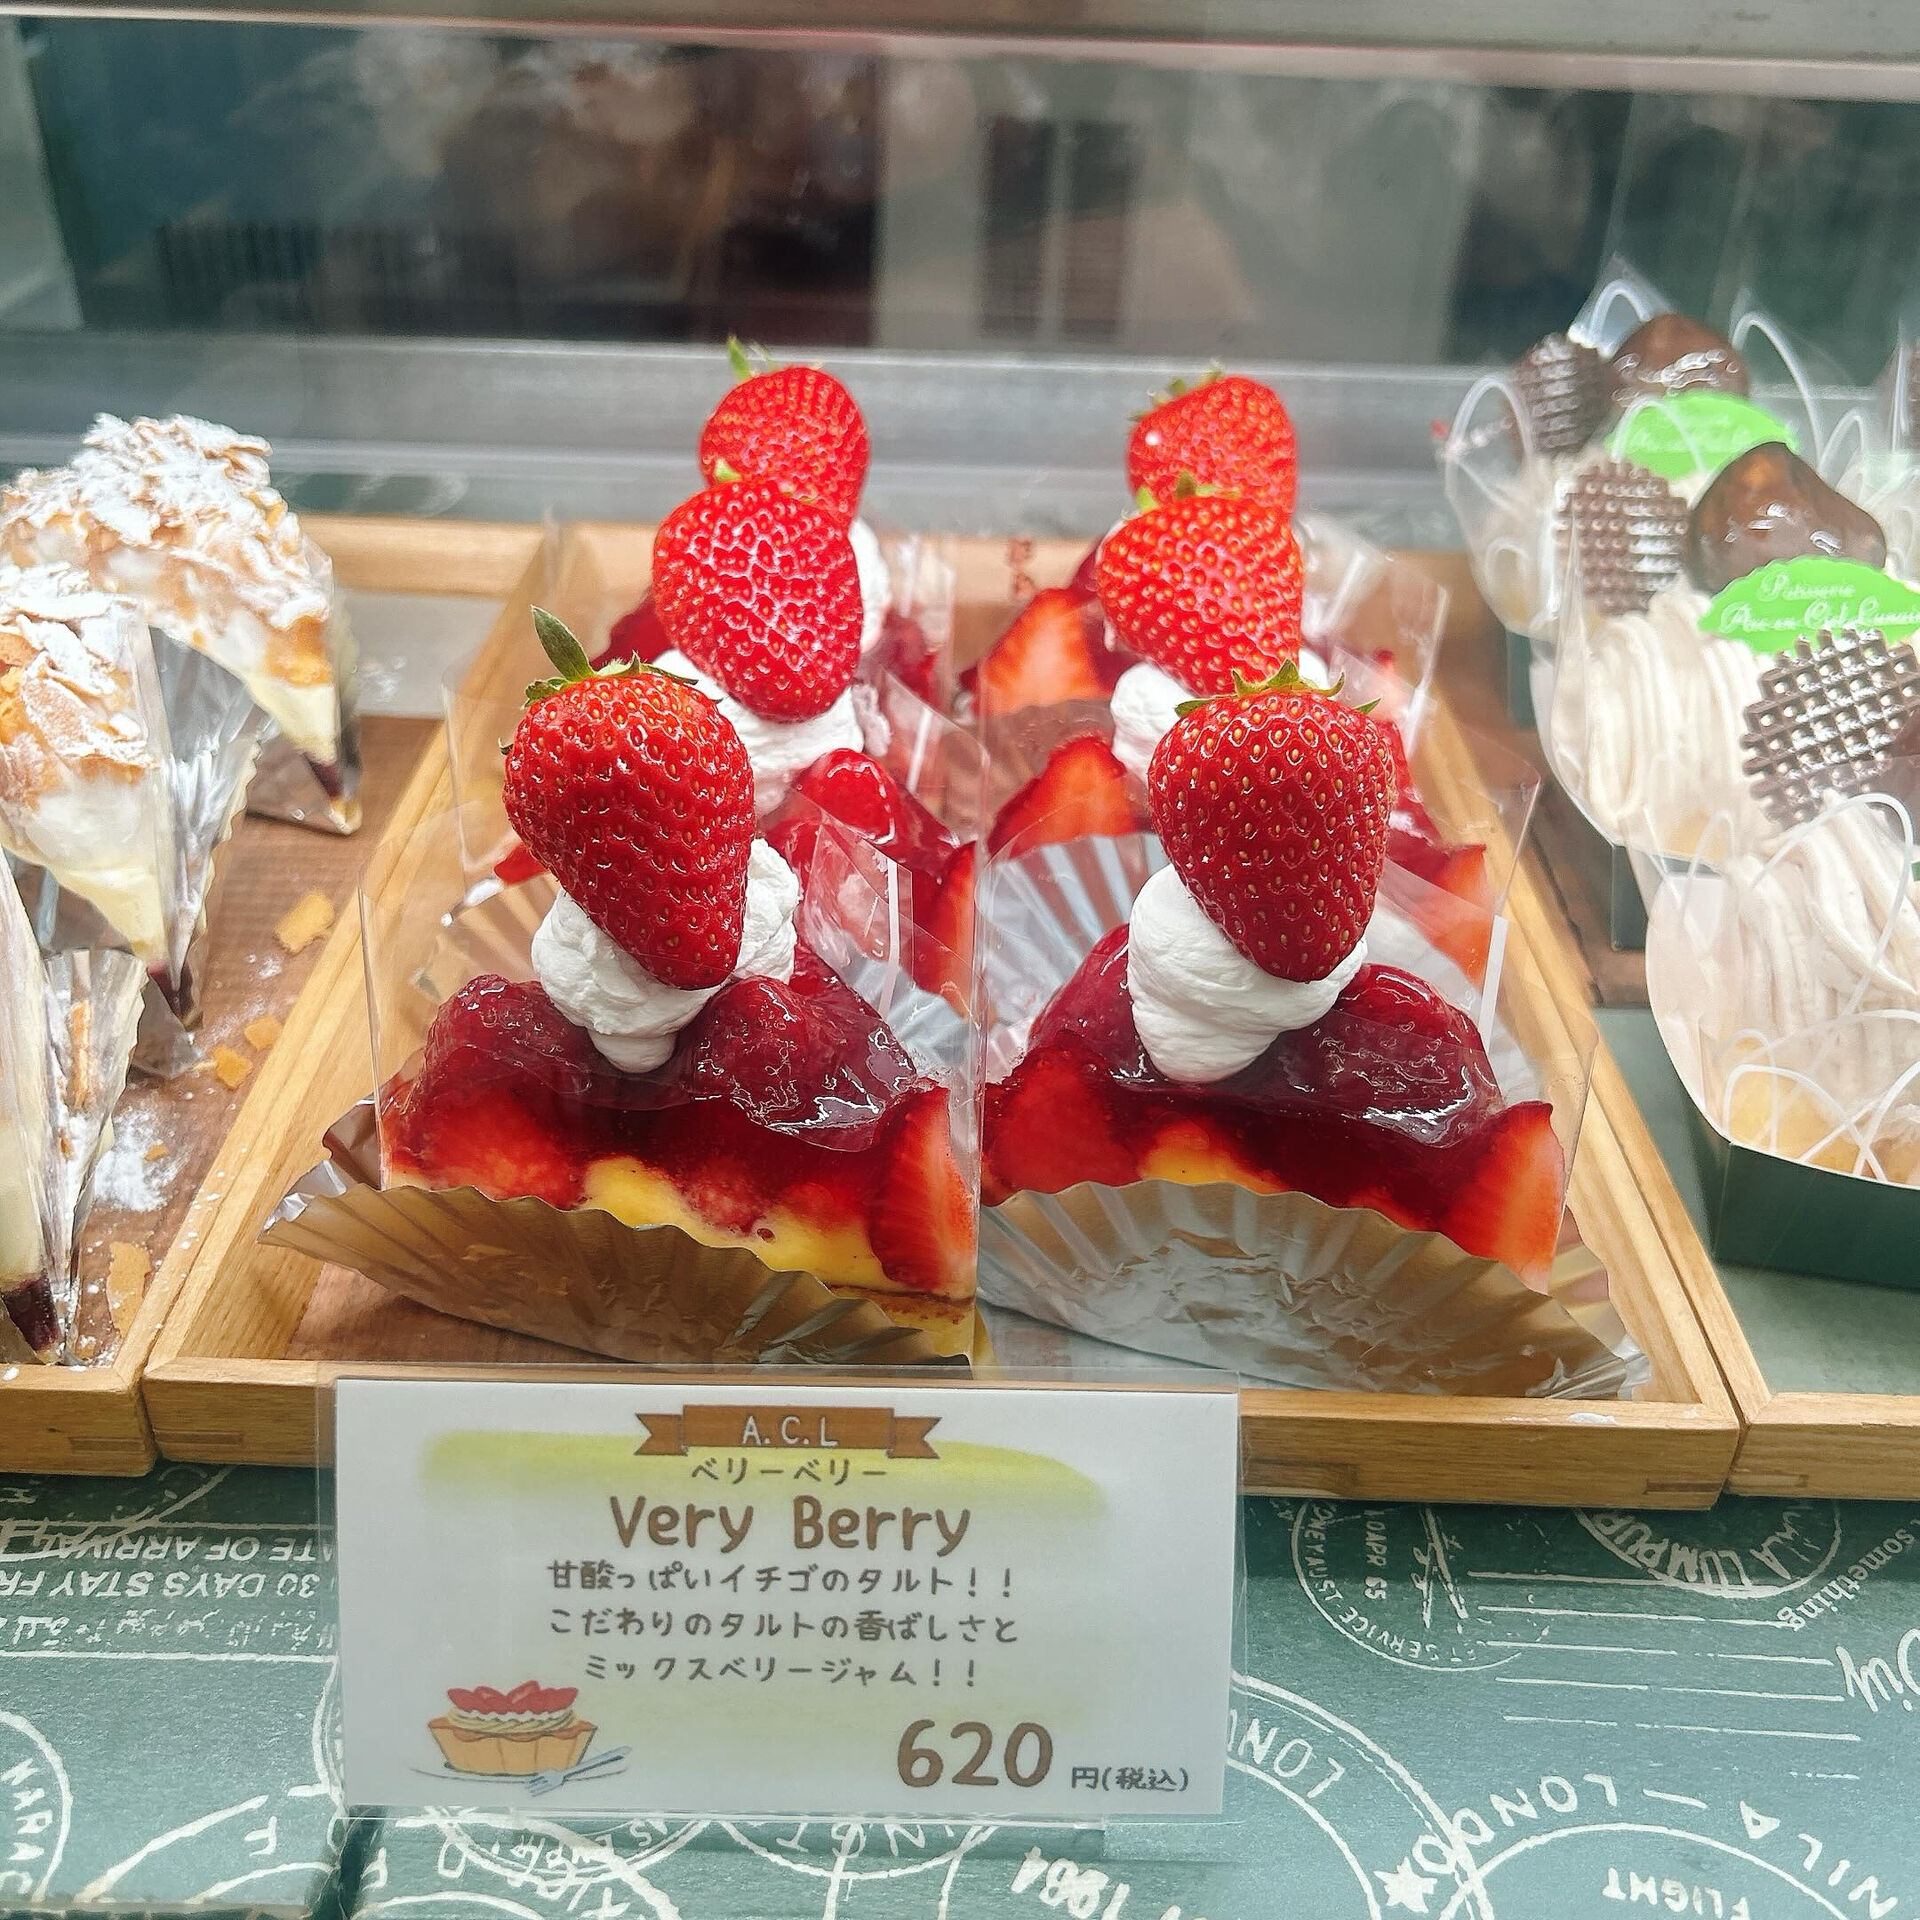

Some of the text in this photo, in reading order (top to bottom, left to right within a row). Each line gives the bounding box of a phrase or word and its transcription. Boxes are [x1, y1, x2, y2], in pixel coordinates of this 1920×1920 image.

[741, 1415, 840, 1447] A.C.L
[691, 1457, 889, 1486] ベリーベリー
[609, 1494, 971, 1558] Very Berry
[204, 1537, 261, 1562] OF
[49, 1570, 155, 1598] STAY
[162, 1571, 266, 1599] DAYS
[276, 1572, 321, 1599] 30
[1776, 1527, 1915, 1632] something
[550, 1608, 1018, 1644] こだわりのタルトの香ばしさと
[896, 1719, 1054, 1788] 620
